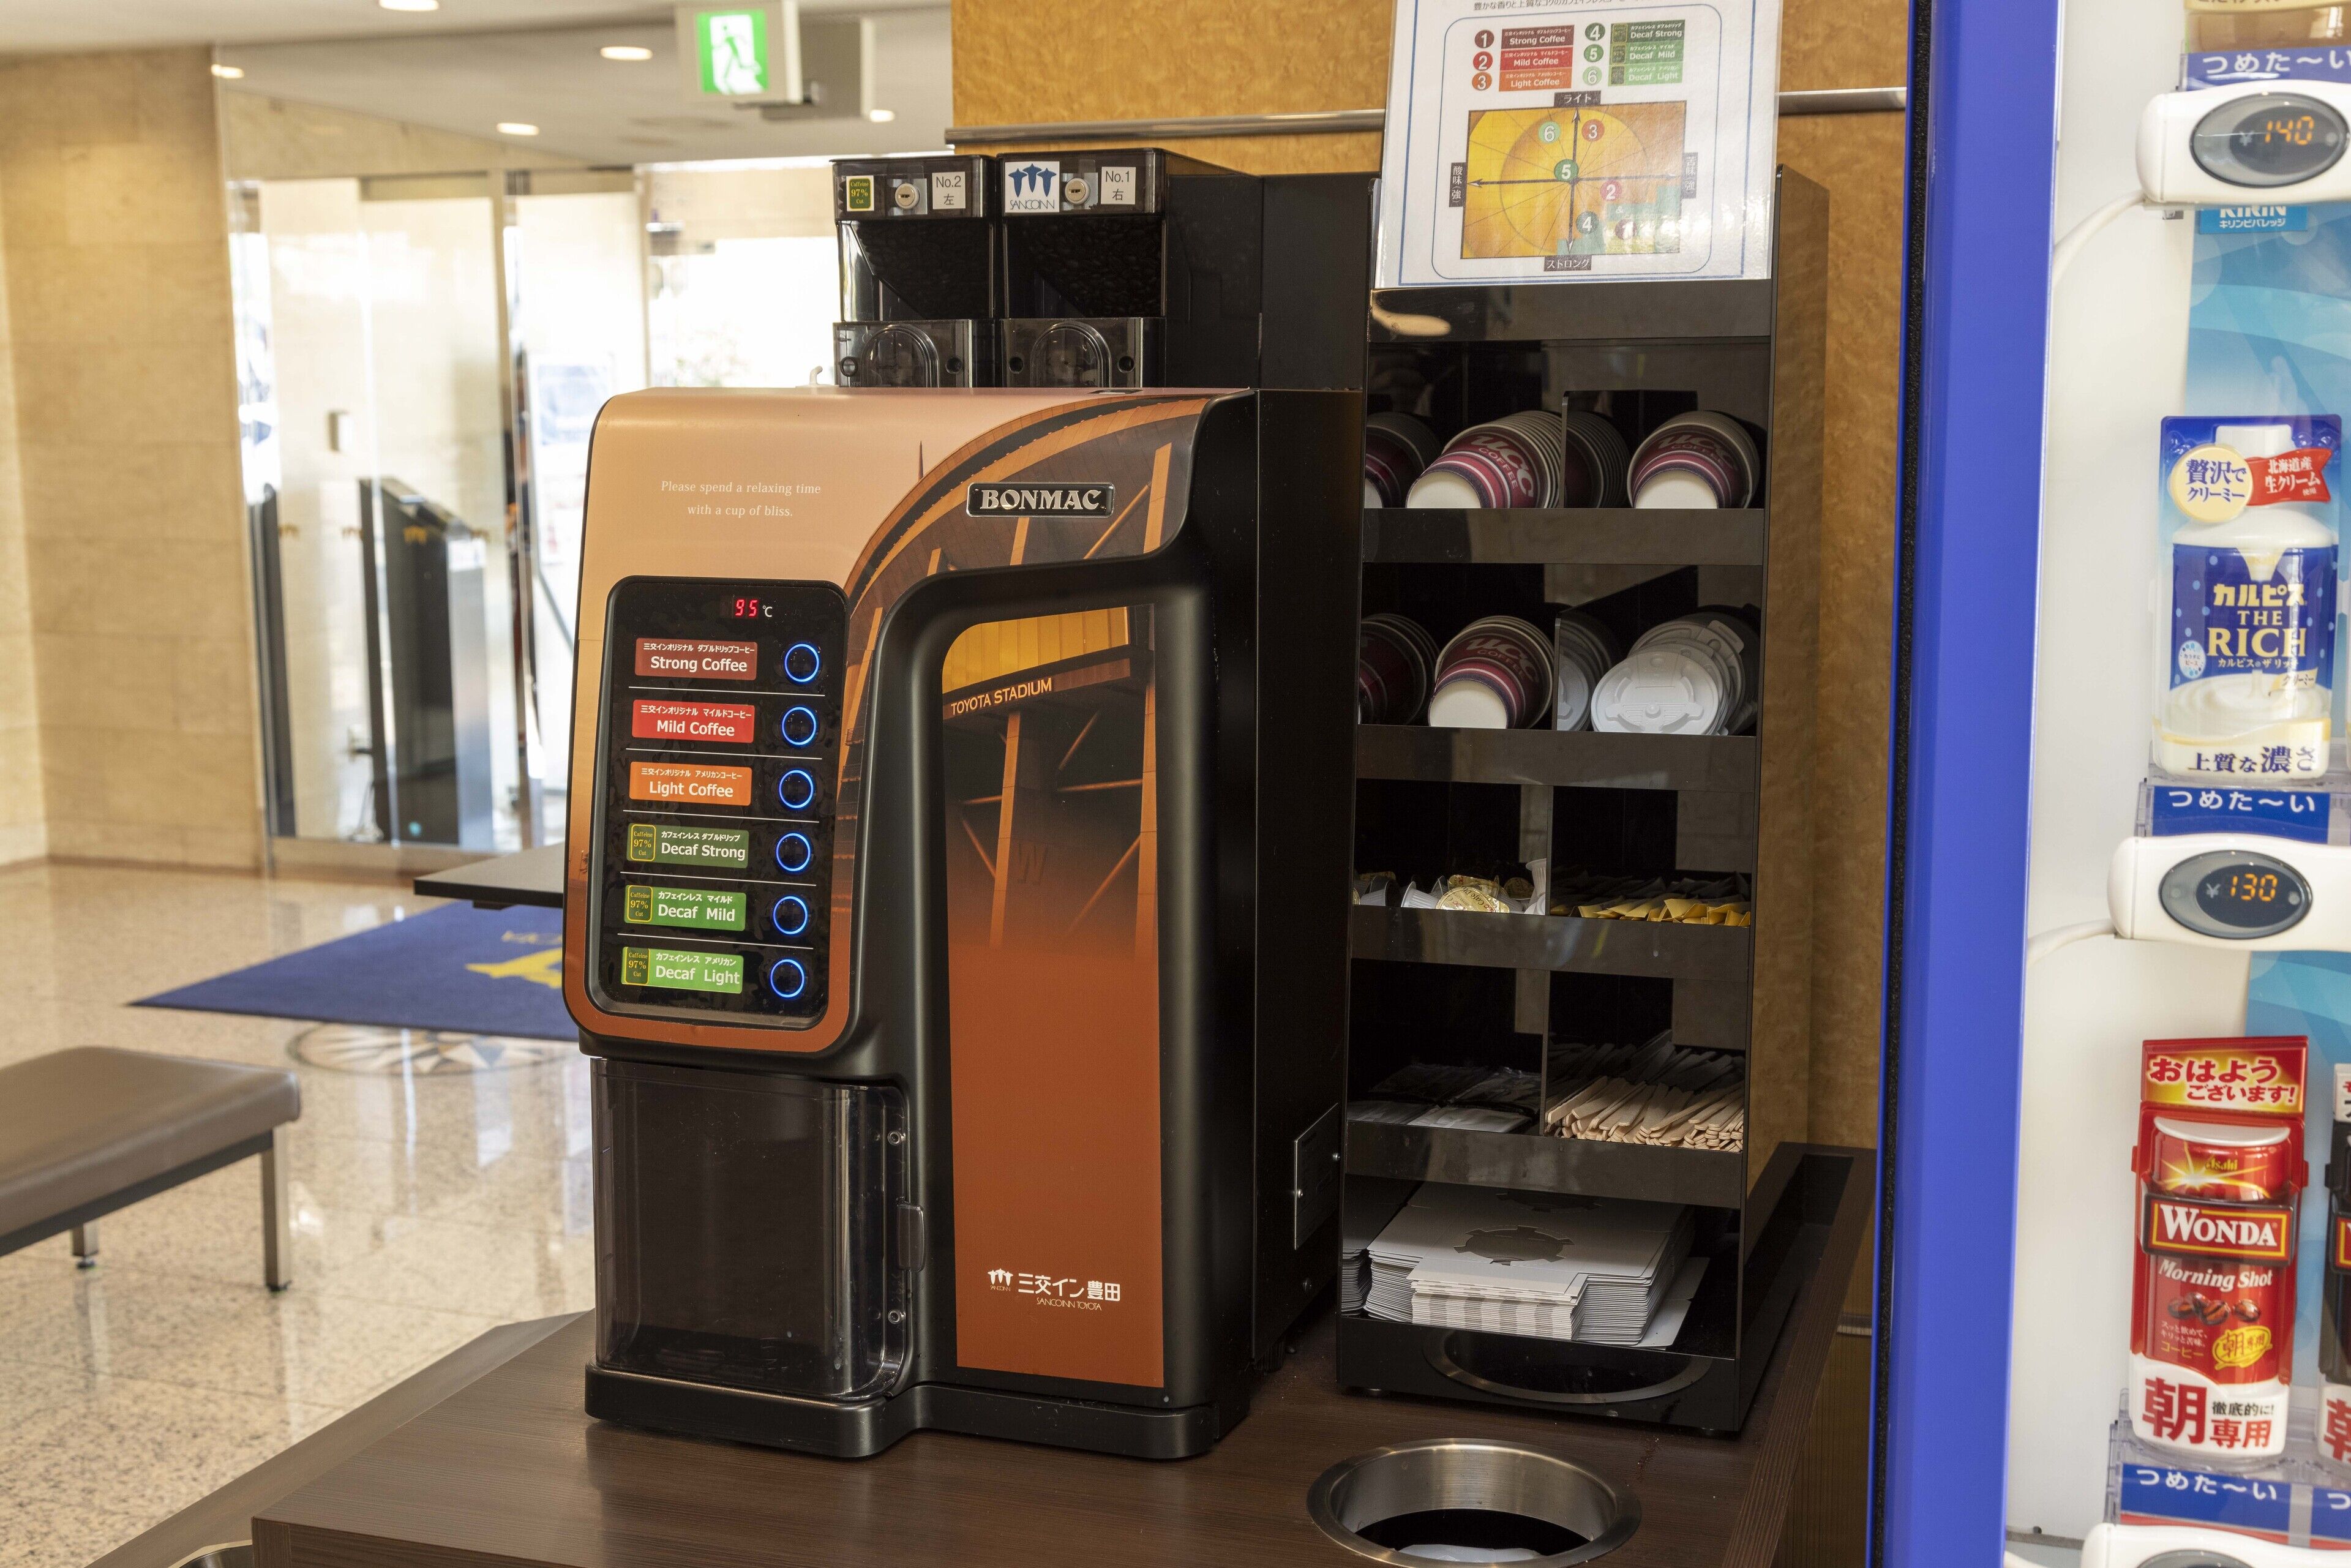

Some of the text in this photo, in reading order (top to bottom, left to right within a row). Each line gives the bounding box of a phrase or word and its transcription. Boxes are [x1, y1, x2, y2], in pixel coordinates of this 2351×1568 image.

[1482, 33, 1487, 47] 1
[1590, 26, 1599, 40] 4
[1590, 48, 1598, 60] 5
[1479, 56, 1488, 69] 2
[1478, 75, 1487, 89] 3
[1588, 70, 1597, 84] 6
[1657, 72, 1678, 81] Light
[1564, 94, 1592, 103] ライト
[1544, 125, 1555, 142] 6
[1588, 124, 1597, 139] 3
[2265, 116, 2315, 146] 140
[1105, 171, 1130, 182] No.1
[1562, 164, 1571, 179] 5
[936, 176, 961, 188] No.2
[943, 193, 954, 205] 左
[1112, 189, 1124, 201] 右
[1606, 184, 1616, 200] 2
[1010, 200, 1055, 210] SANCOINN
[1582, 217, 1592, 231] 4
[2219, 218, 2286, 228] キリンビバレッジ
[1547, 259, 1589, 269] ストロング
[1479, 448, 1518, 489] COFFEE
[2186, 459, 2246, 485] 贅沢で
[2267, 456, 2313, 475] 北海道産
[661, 481, 696, 491] Please
[699, 482, 732, 494] spend
[746, 482, 792, 496] relaxing
[796, 484, 821, 494] time
[2265, 471, 2321, 494] 生クリーム
[980, 489, 1101, 510] BONMAC
[2187, 487, 2246, 503] クリーミー
[688, 505, 711, 515] with
[726, 507, 745, 518] cup
[749, 505, 761, 516] of
[764, 505, 793, 517] bliss.
[2213, 583, 2305, 607] カルピス
[735, 599, 759, 618] 95
[2237, 610, 2283, 626] THE
[643, 643, 755, 654] 三交インオリジナル ダブルドリップコーヒー
[2207, 627, 2307, 657] RICH
[650, 655, 748, 672] Strong Coffee
[951, 678, 1052, 715] TOYOTA STADIUM
[640, 705, 752, 719] 三交インオリジナル マイルドコーヒー
[656, 719, 735, 737] Mild Coffee
[2188, 746, 2316, 773] 上質な濃さ
[641, 768, 742, 779] 三交インオリジナル アメリカンコーヒー
[650, 781, 733, 798] Light Coffee
[633, 839, 651, 848] 97%
[661, 830, 740, 842] カフェインレス ダブルドリップ
[661, 842, 746, 861] Decaf Strong
[2230, 873, 2278, 901] 130
[630, 900, 648, 909] 97%
[658, 891, 733, 904] カフェインレス マイルド
[658, 904, 735, 921] Decaf Mild
[628, 961, 647, 969] 97%
[656, 953, 737, 966] カフェインレス アメリカン
[655, 966, 740, 985] Decaf Light
[2149, 1057, 2278, 1084] おはよう
[2205, 1155, 2238, 1172] Asahi
[2160, 1204, 2277, 1247] WONDA
[2158, 1259, 2273, 1292] Morning Shot
[1018, 1273, 1120, 1302] 三交イン豊田
[1037, 1297, 1102, 1311] SANCOINN TOYOTA
[2161, 1341, 2203, 1359] コーヒー
[2222, 1332, 2244, 1358] 朝
[2142, 1376, 2208, 1444] 朝
[2212, 1401, 2274, 1417] 徹底的に!
[2210, 1419, 2272, 1449] 専用
